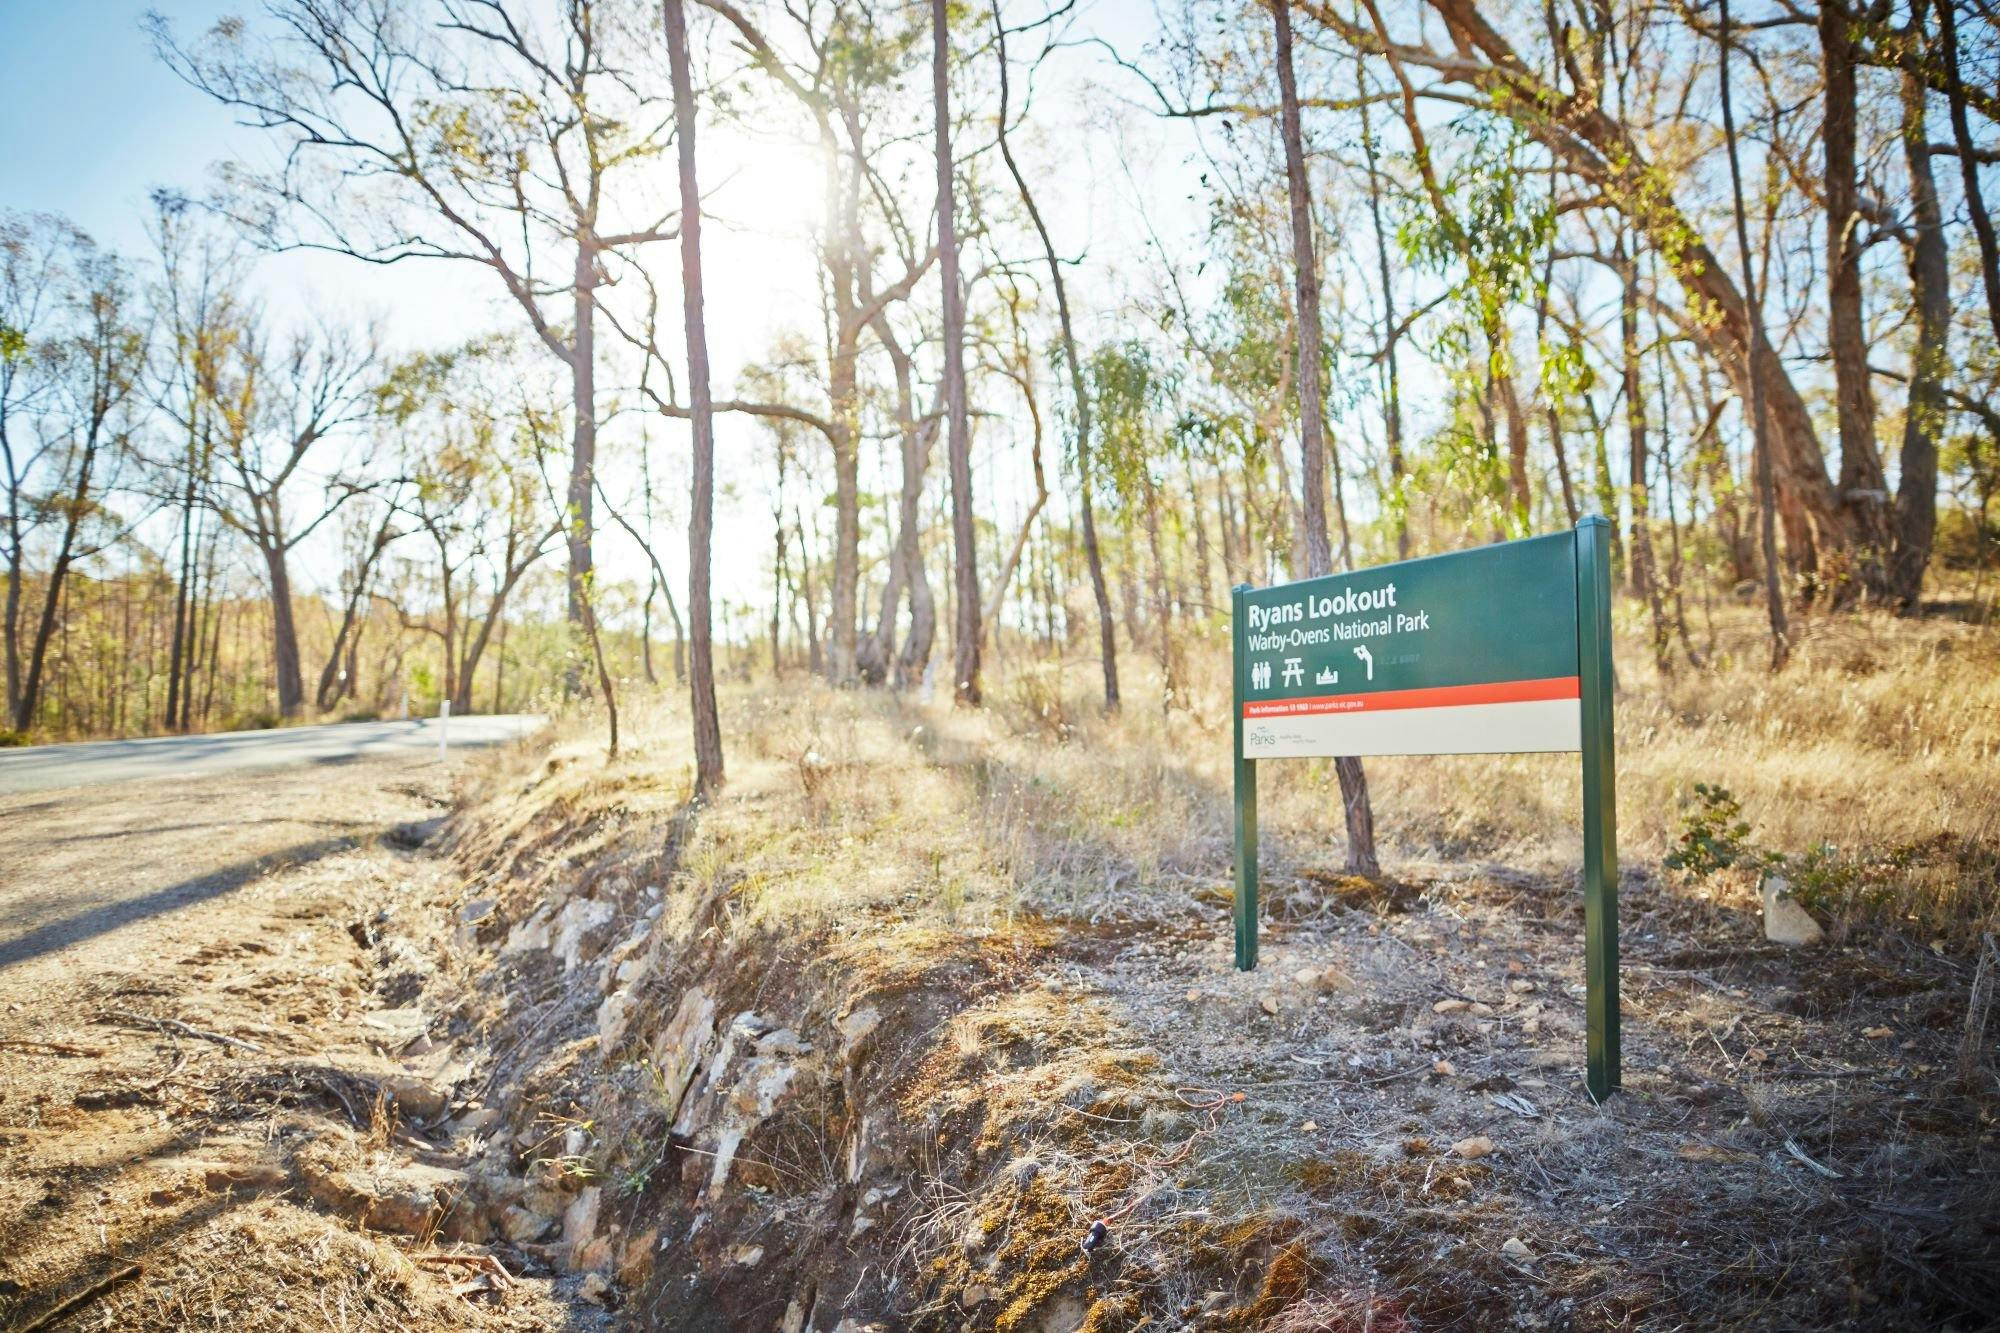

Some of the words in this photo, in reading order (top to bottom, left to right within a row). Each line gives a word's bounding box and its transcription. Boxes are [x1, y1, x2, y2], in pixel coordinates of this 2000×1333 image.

[1249, 602, 1303, 632] Ryans
[1308, 582, 1397, 619] Lookout
[1248, 627, 1330, 652] Warby-Ovens
[1333, 614, 1392, 641] National
[1396, 609, 1430, 633] Park
[1249, 705, 1260, 714] Park
[1250, 733, 1275, 745] Parks
